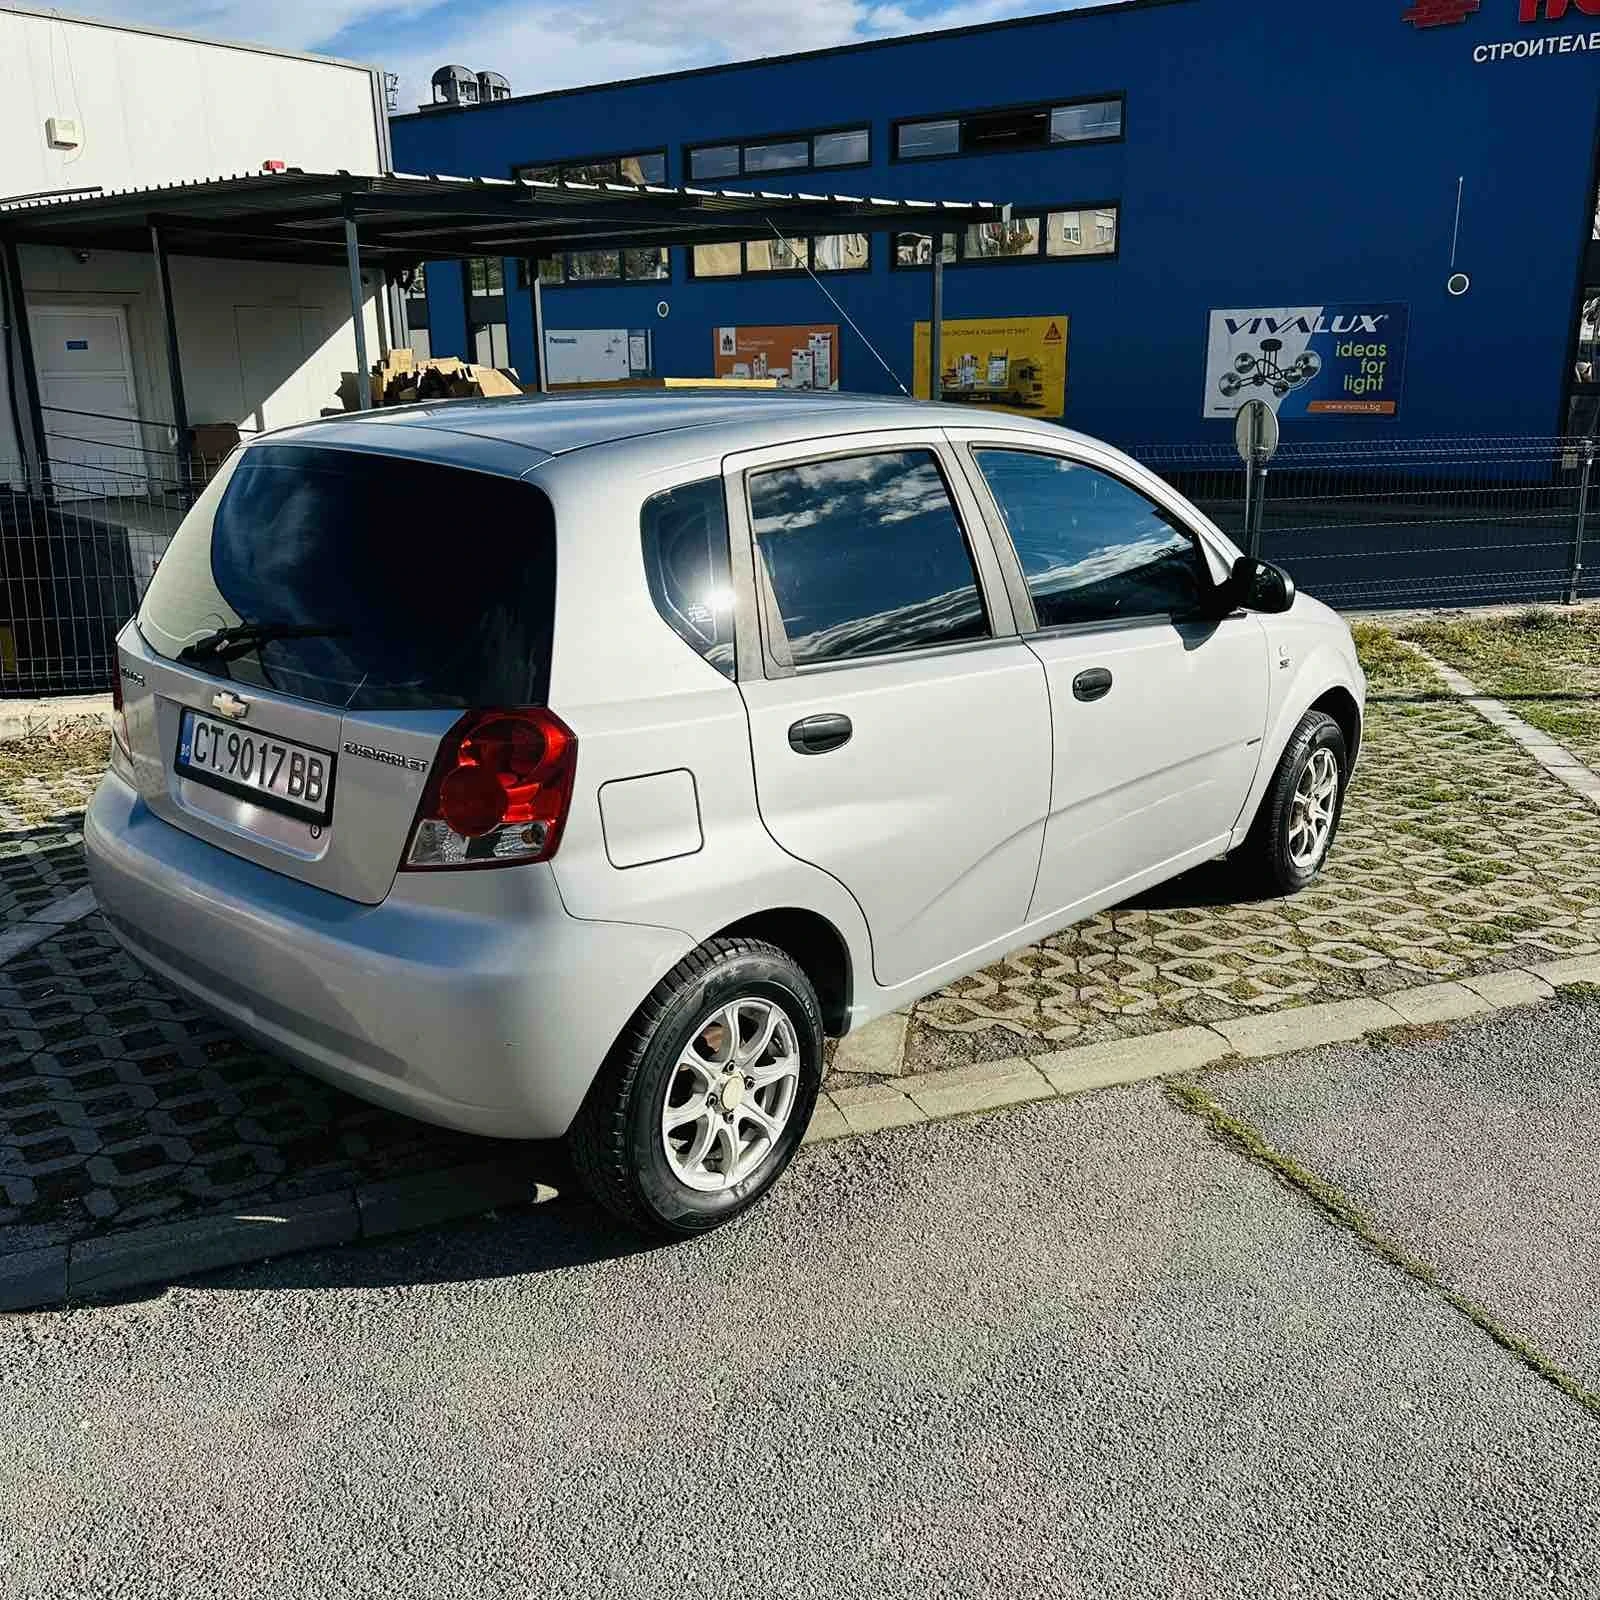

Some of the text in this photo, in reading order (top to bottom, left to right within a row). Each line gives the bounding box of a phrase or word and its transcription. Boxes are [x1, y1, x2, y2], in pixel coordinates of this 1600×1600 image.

[1224, 314, 1385, 335] VIVALUX
[1335, 340, 1387, 358] ideas
[1360, 357, 1386, 375] for
[1343, 374, 1384, 395] light
